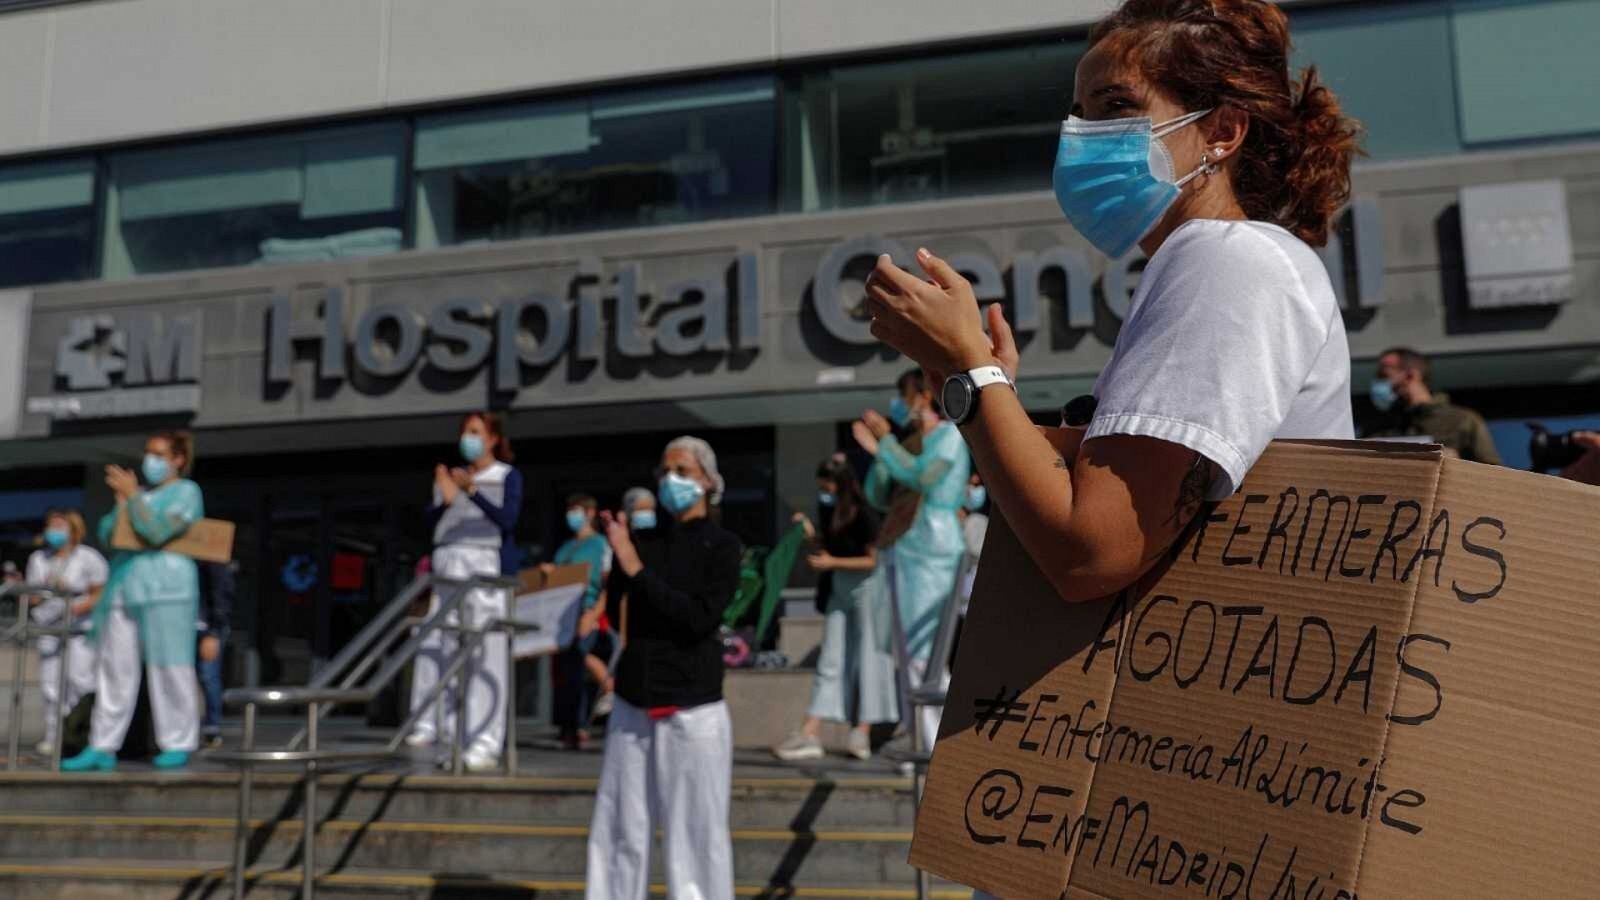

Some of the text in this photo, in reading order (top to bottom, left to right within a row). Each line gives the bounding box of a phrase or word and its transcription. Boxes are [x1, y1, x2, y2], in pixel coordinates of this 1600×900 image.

[267, 252, 759, 390] Hospital
[1191, 485, 1507, 603] FERMERAS
[1082, 588, 1450, 725] AGOTADAS
